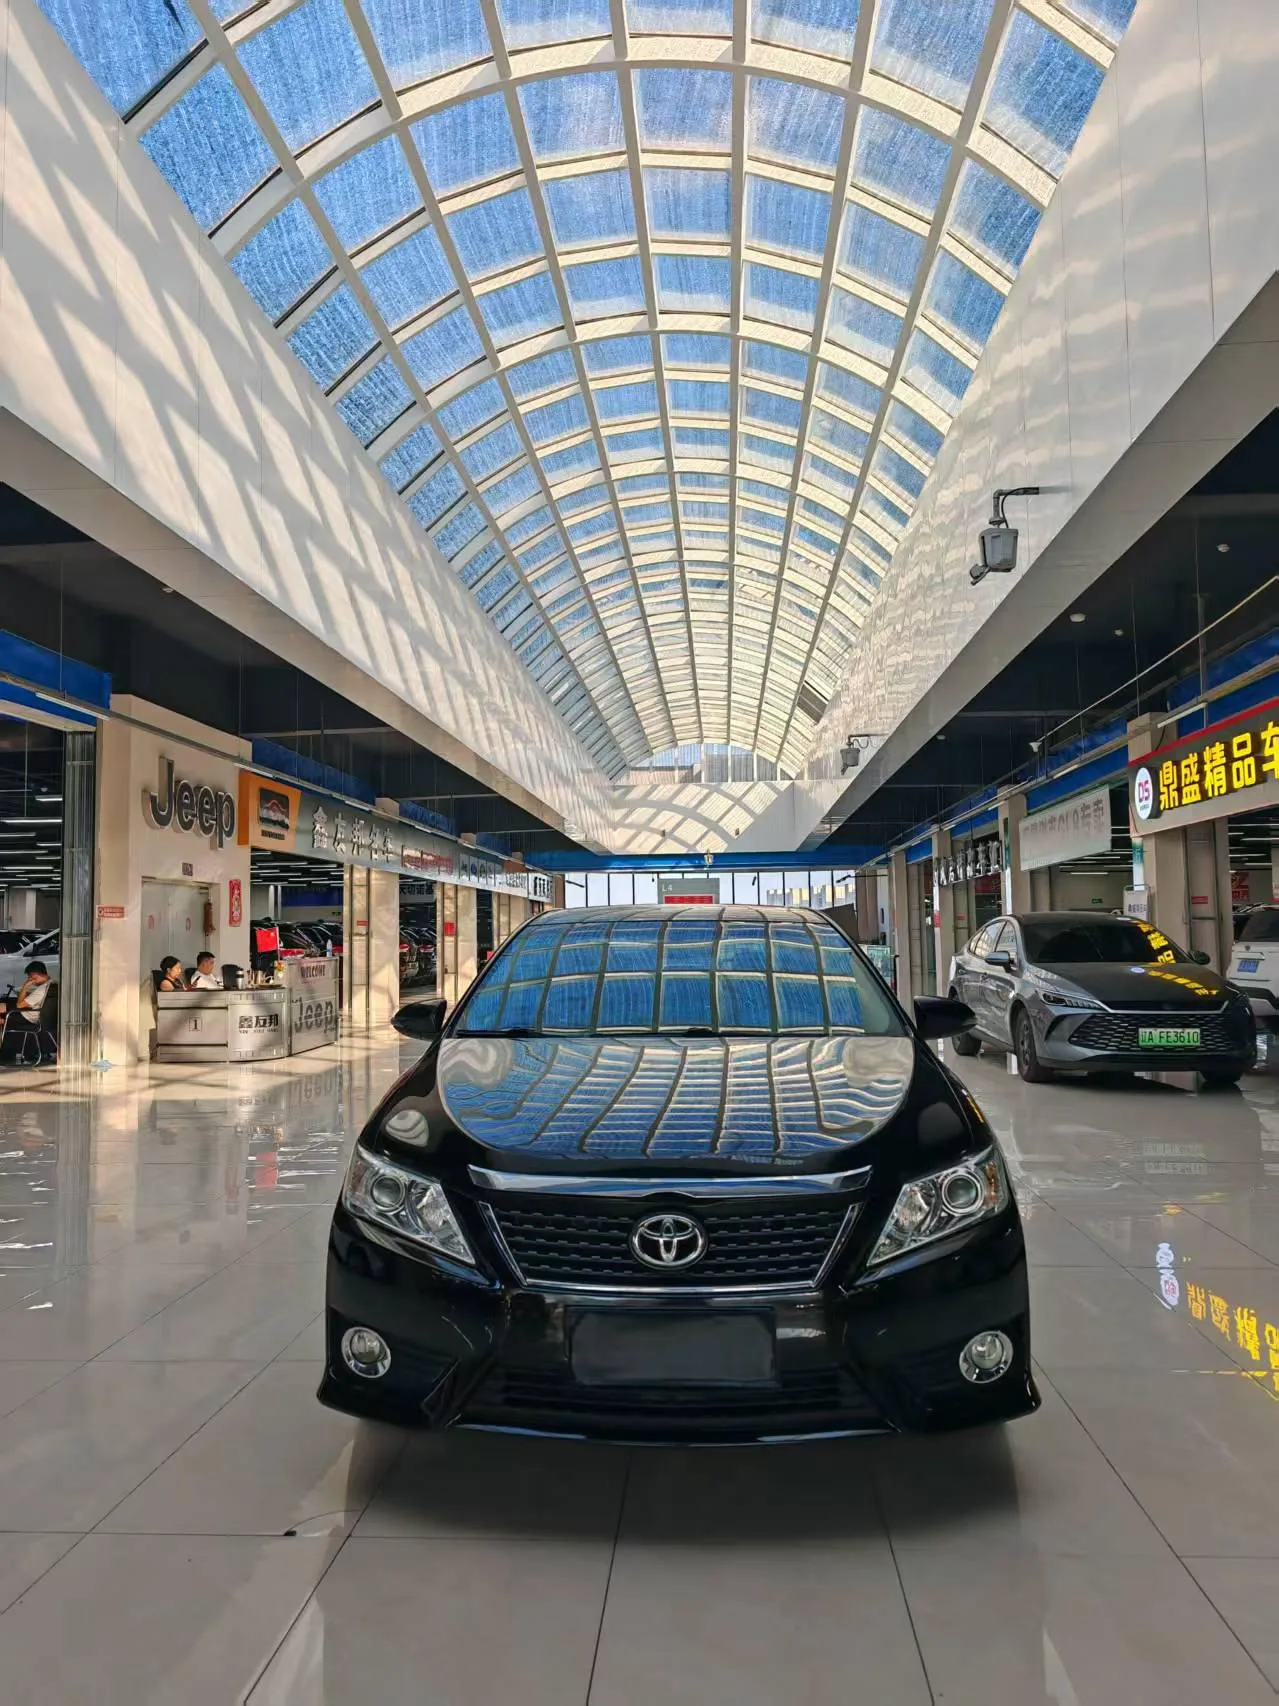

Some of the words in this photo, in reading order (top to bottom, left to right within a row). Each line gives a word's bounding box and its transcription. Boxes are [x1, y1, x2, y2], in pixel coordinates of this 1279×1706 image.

[146, 756, 236, 850] Jeep
[238, 1013, 280, 1029] 鑫友邦
[294, 996, 334, 1034] Jeep
